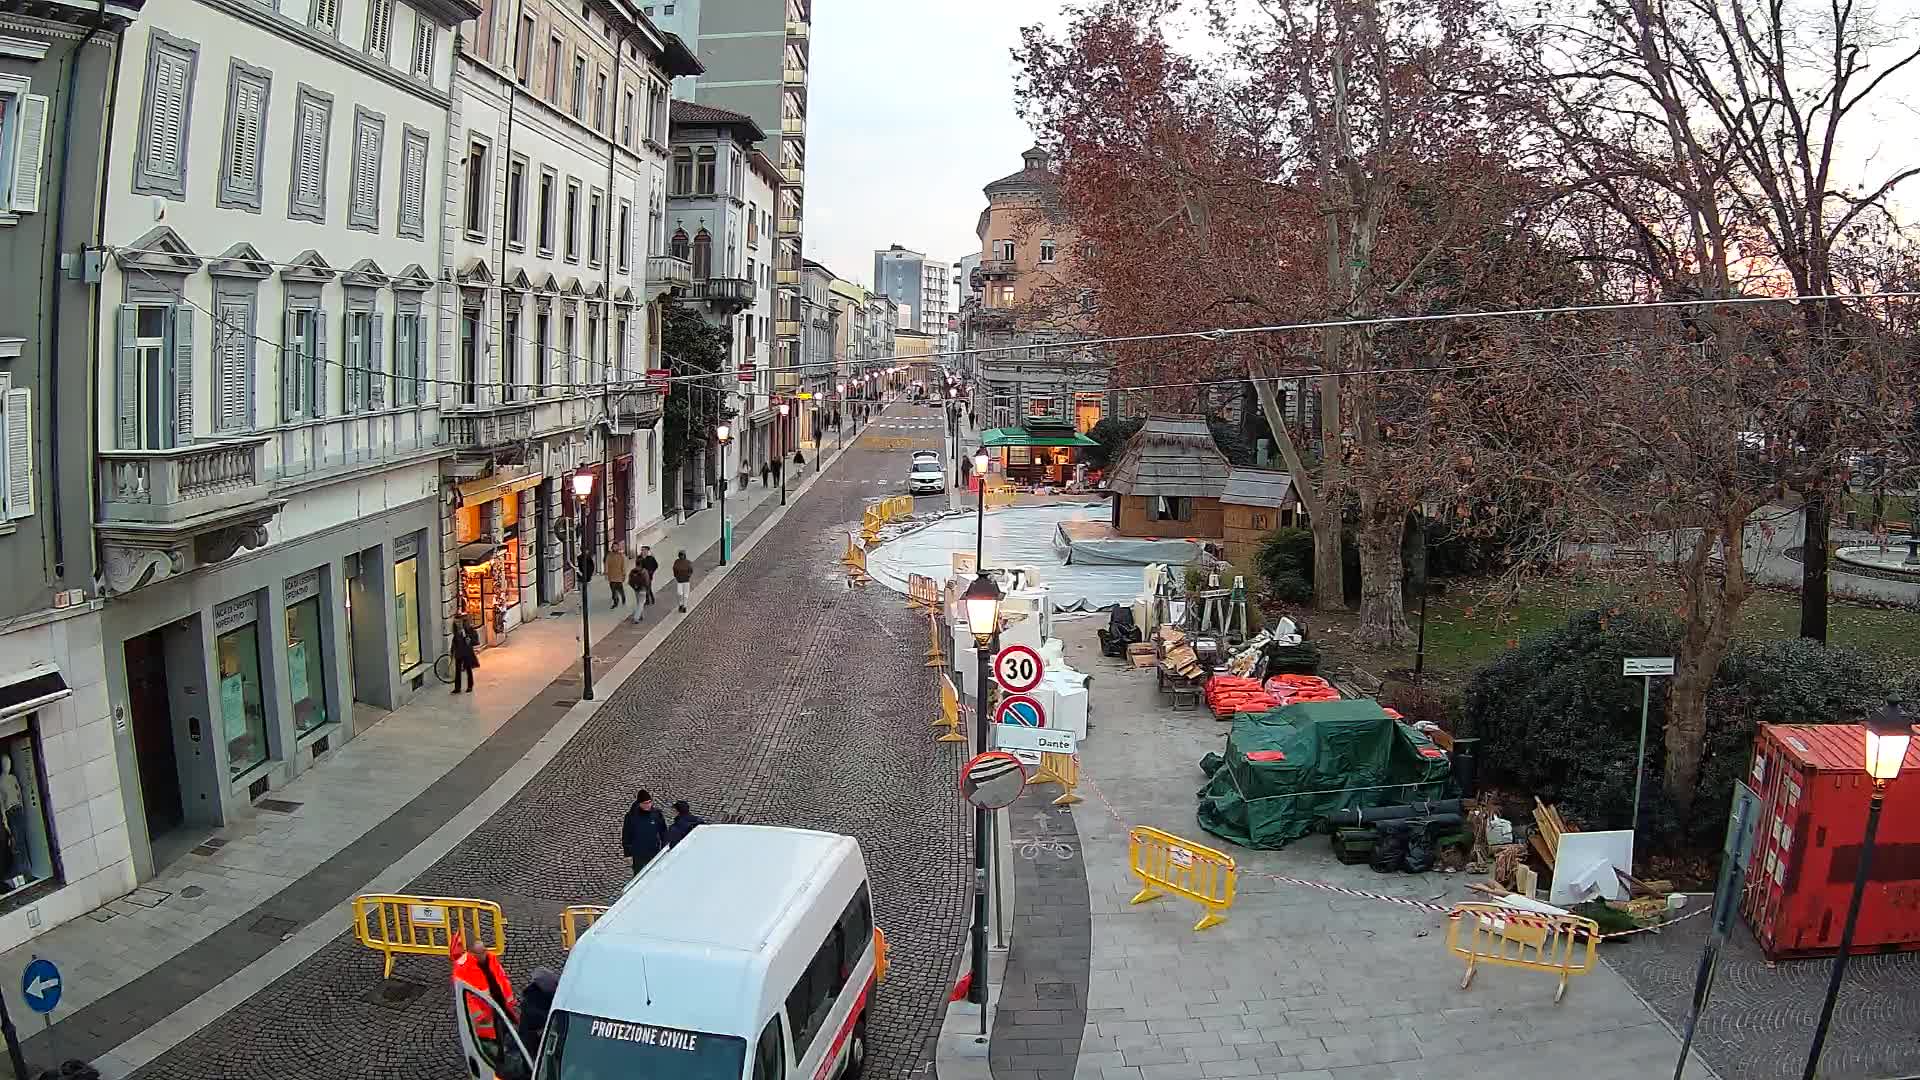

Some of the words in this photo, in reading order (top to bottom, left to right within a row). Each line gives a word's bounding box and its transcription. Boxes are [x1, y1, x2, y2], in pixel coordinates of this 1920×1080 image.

[1005, 658, 1033, 680] 30
[1039, 738, 1070, 748] Dante
[591, 1020, 657, 1045] PROTEZIONE
[660, 1030, 697, 1051] CIVILE
